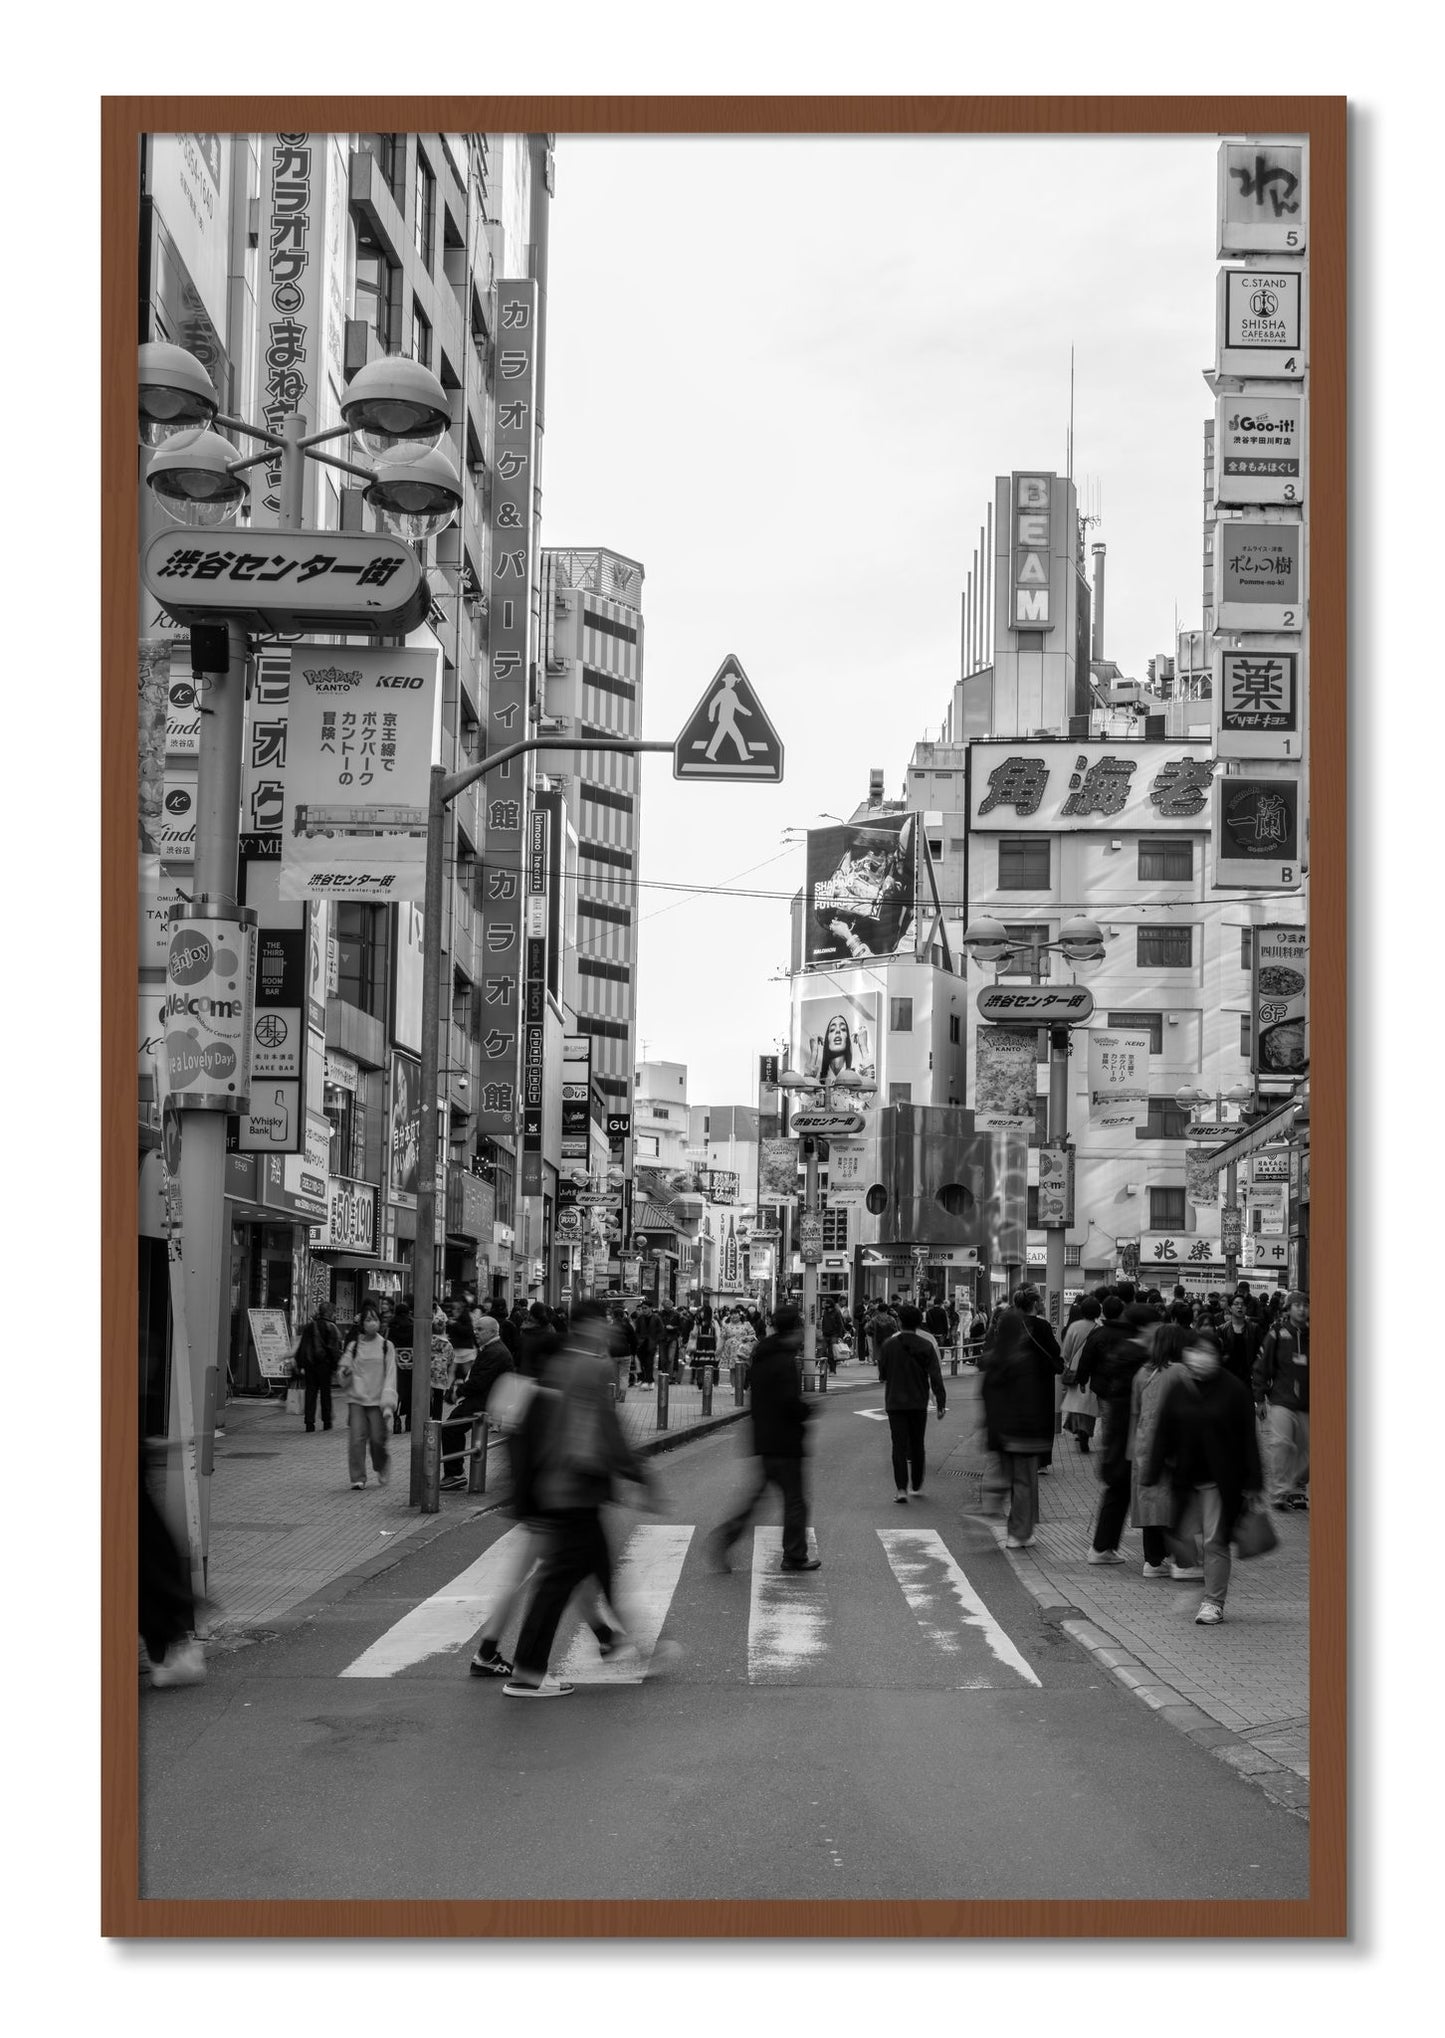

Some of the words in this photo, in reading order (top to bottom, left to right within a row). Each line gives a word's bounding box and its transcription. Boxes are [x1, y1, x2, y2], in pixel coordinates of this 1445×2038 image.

[1286, 230, 1299, 247] 5
[1241, 278, 1287, 289] C.STAND
[1241, 318, 1287, 330] SHISHA
[1241, 330, 1287, 339] CAFE&BAR
[1239, 416, 1295, 433] Goo-it!
[1228, 461, 1297, 474] 全身もみほぐし
[1283, 484, 1296, 501] 3
[1017, 478, 1050, 621] BEAM
[156, 548, 406, 588] 渋谷センター街
[1282, 610, 1296, 627] 2
[315, 684, 351, 692] KANTO
[375, 675, 425, 690] KEIO
[1231, 658, 1284, 711] 薬
[1226, 713, 1289, 728] マツモトキヨシ
[320, 711, 337, 754] 冒険へ
[338, 711, 357, 786] カントーの
[358, 711, 378, 787] ポケパーク
[379, 712, 398, 772] 京王線で
[1282, 738, 1292, 755] 1
[977, 755, 1218, 816] 角海老
[533, 814, 543, 851] kimono
[307, 873, 397, 887] 渋谷センター街
[1280, 866, 1293, 883] B
[262, 949, 285, 957] THIRD
[266, 941, 281, 949] THE
[169, 942, 211, 977] Enjoy
[262, 977, 284, 985] ROOM
[166, 992, 243, 1018] Welcome
[984, 994, 1088, 1008] 渋谷センター街
[1259, 1003, 1288, 1024] 6F
[183, 1050, 213, 1076] Lovely
[214, 1051, 235, 1066] Day!
[254, 1064, 275, 1072] SAKE
[278, 1064, 295, 1072] BAR
[249, 1125, 270, 1135] Bank
[250, 1116, 284, 1127] Whisky
[608, 1119, 629, 1131] GU
[727, 1237, 736, 1280] BEER
